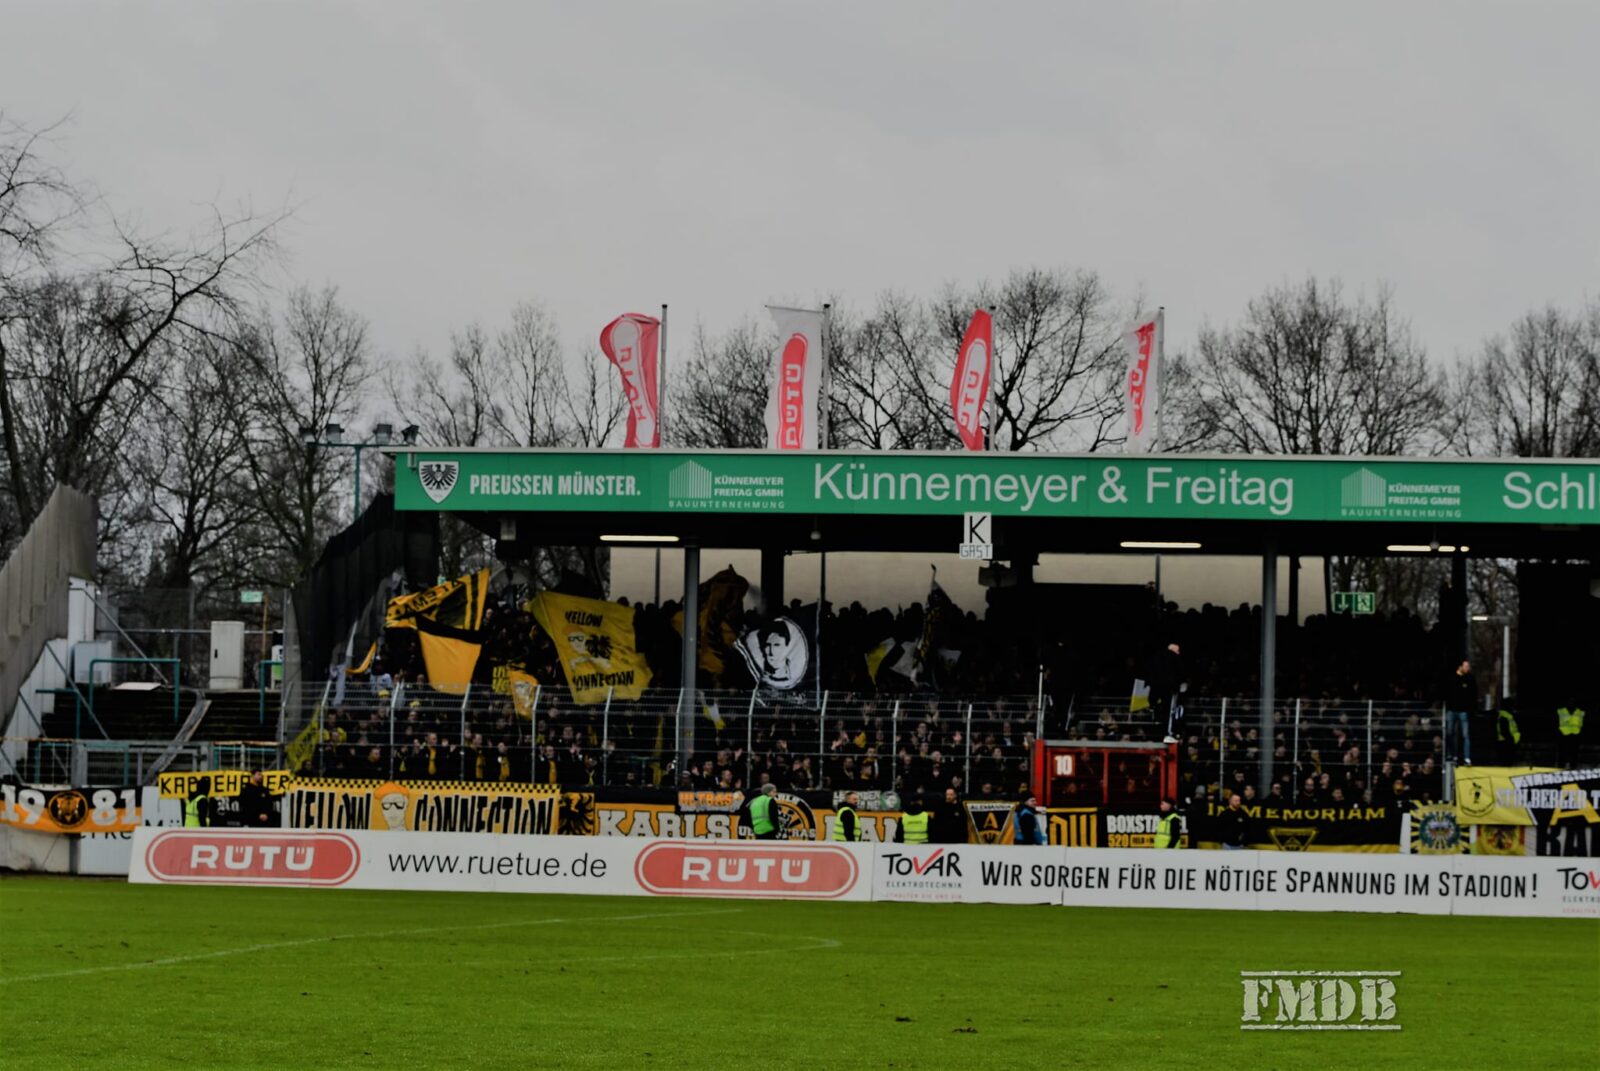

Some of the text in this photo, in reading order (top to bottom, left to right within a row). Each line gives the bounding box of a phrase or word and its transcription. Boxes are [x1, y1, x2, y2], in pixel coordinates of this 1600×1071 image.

[958, 370, 981, 427] ÜTÜ
[469, 471, 641, 497] PREUSSEN MÜNSTER.
[714, 475, 784, 487] KÜNNEMEYER
[814, 462, 1295, 516] Künnemeyer & Freitag
[1388, 483, 1461, 495] KÜNNEMEYER
[714, 488, 784, 498] FREITAG GMBH
[1502, 471, 1600, 511] Schl
[668, 500, 785, 510] BAUUNTERNEHMUNG
[1388, 496, 1461, 506] FREITAG GMBH
[1341, 508, 1462, 518] BAUUNTERNEHMUNG
[970, 515, 986, 543] K
[960, 544, 990, 559] GAST
[565, 611, 603, 627] YELLOW
[1054, 755, 1072, 776] 10
[1240, 804, 1386, 822] MEMORIAM
[190, 845, 315, 870] RÜTÜ
[389, 852, 606, 878] www.ruetue.de
[682, 857, 811, 883] RÜTÜ
[981, 861, 1022, 886] WIR
[1031, 865, 1109, 889] SORGEN
[1120, 863, 1155, 890] FÜR
[1165, 868, 1196, 891] DIE
[1206, 865, 1277, 892] NÖTIGE
[1286, 867, 1395, 895] SPANNUNG
[1405, 874, 1428, 895] IM
[887, 881, 963, 889] ELEKTROTECHNIK
